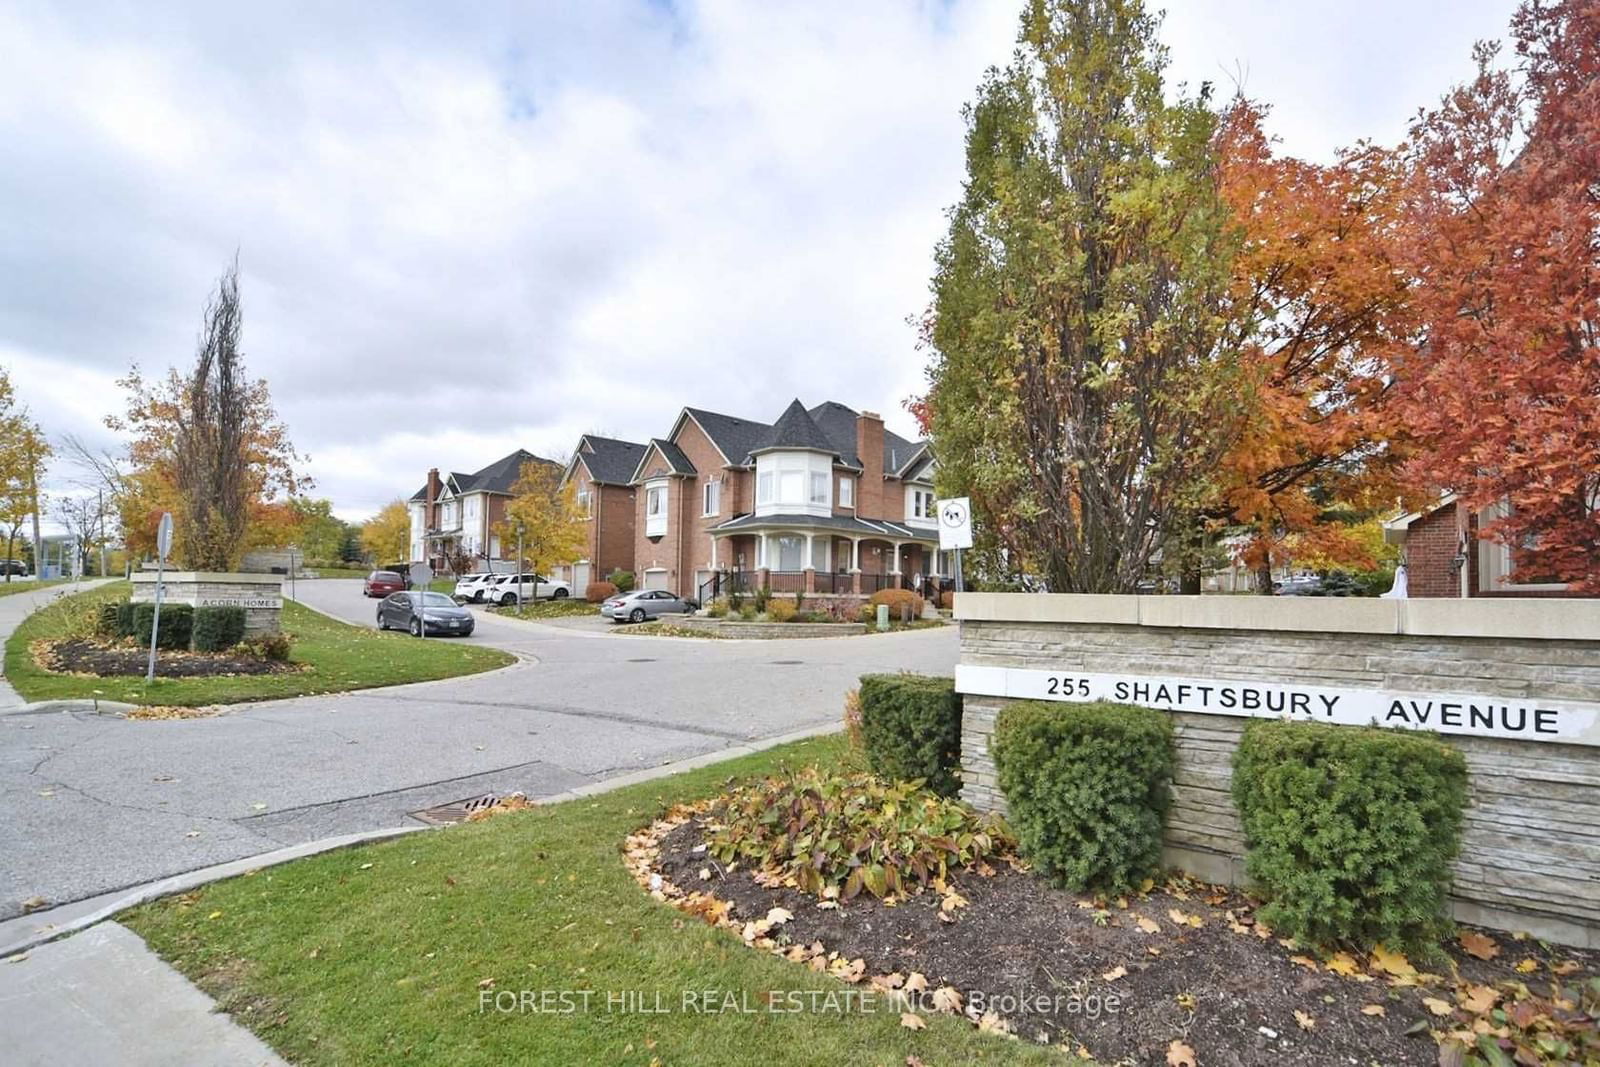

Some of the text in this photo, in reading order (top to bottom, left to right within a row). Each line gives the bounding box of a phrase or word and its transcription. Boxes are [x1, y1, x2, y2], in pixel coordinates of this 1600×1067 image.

[202, 599, 278, 607] ACORN HOMES
[1047, 677, 1559, 734] 255 SHAFTSBURY AVENUE
